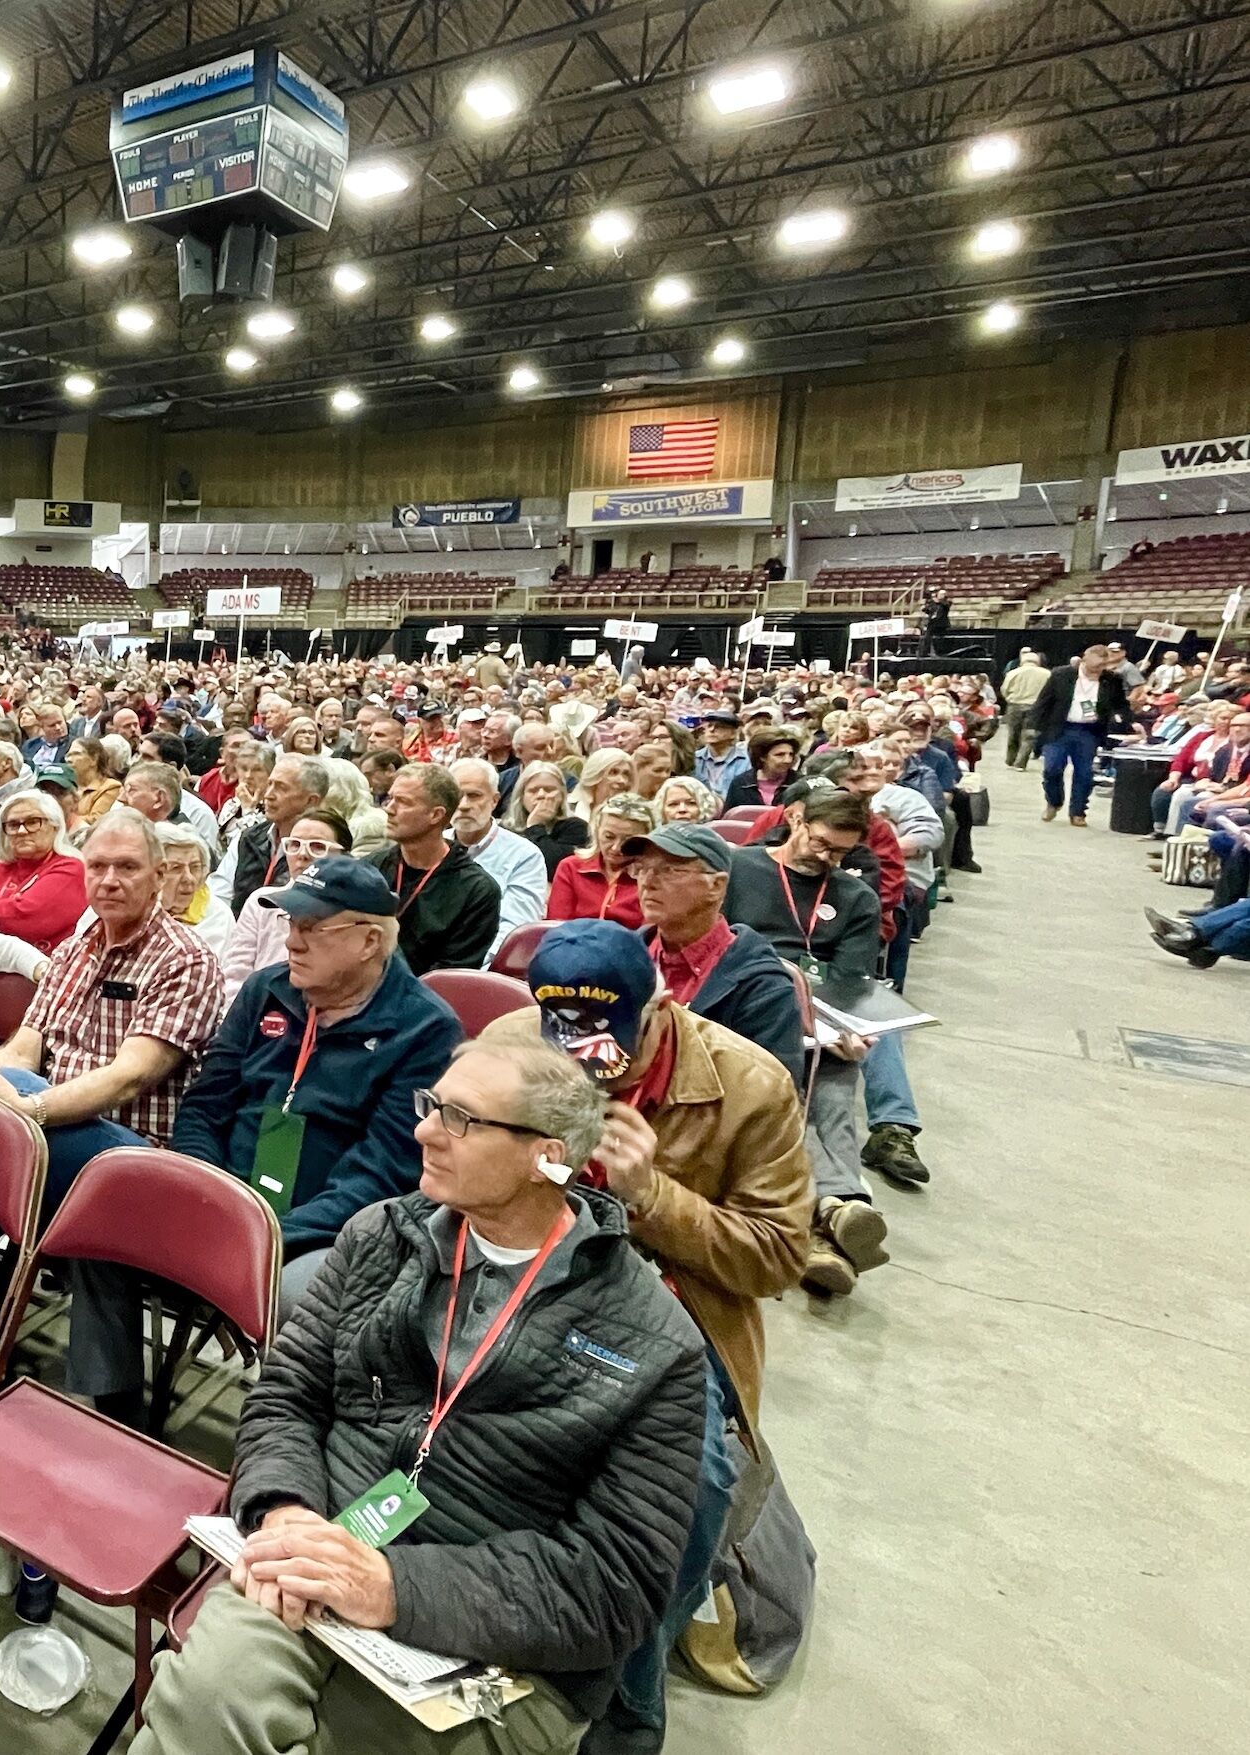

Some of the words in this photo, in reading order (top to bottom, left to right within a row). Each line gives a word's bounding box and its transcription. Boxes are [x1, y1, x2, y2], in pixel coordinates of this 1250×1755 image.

[235, 113, 258, 126] FOULS
[173, 130, 199, 143] PLAYER
[119, 148, 141, 160] FOULS
[218, 150, 255, 169] VISITOR
[173, 168, 195, 180] PERIOD
[128, 177, 158, 193] HOME
[1161, 440, 1250, 469] WAX
[620, 488, 729, 517] SOUTHWEST
[677, 500, 729, 516] MOTORS
[442, 511, 494, 523] PUEBLO
[221, 594, 260, 610] ADAMS
[619, 625, 642, 636] BENT
[858, 622, 893, 636] LARIMER
[579, 985, 620, 1004] NAVY
